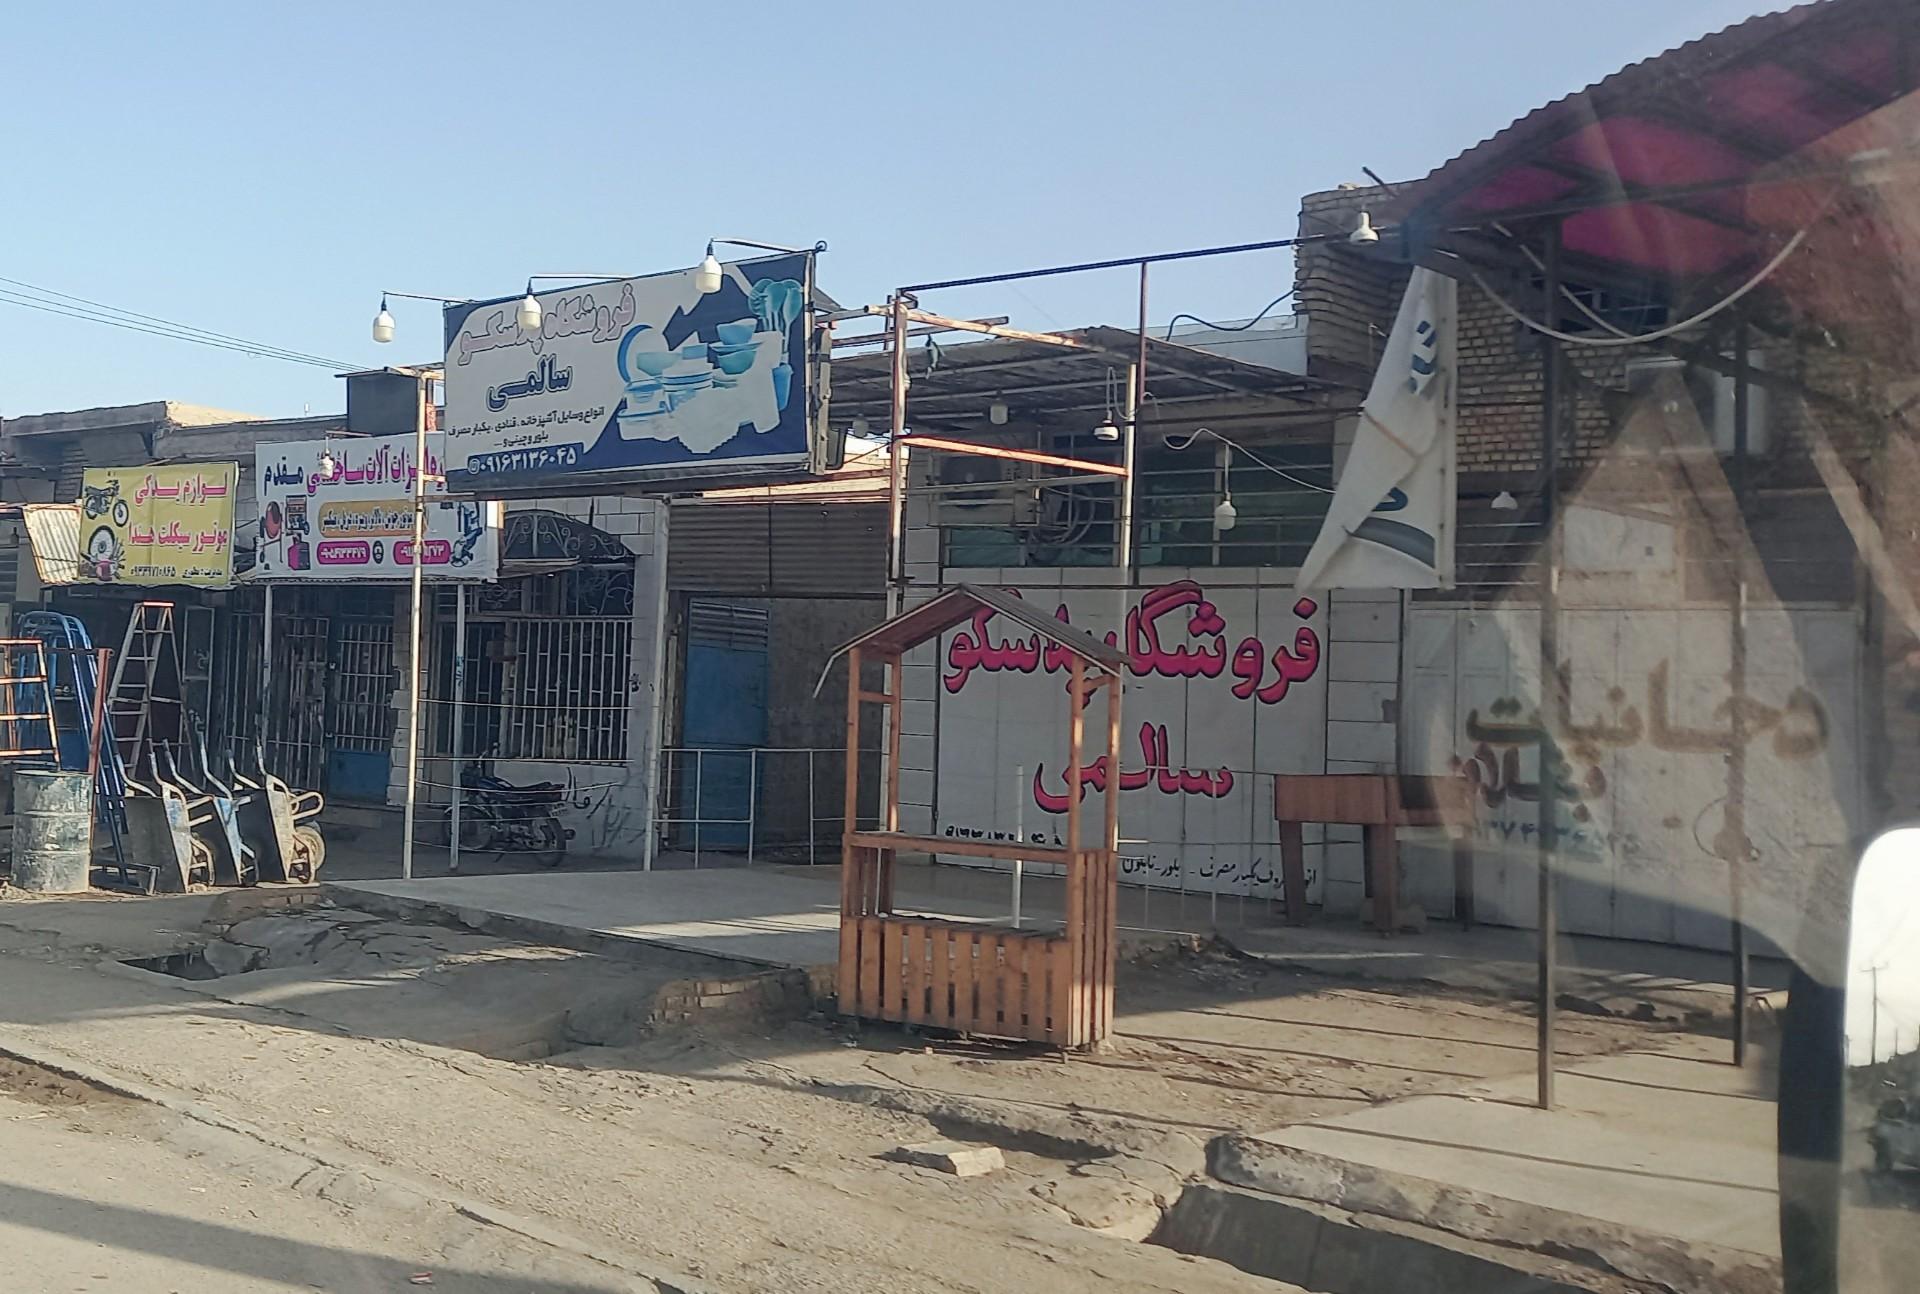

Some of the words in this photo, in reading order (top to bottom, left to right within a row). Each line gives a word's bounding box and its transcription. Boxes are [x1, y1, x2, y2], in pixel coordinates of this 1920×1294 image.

[458, 305, 544, 366] پسکو
[544, 283, 636, 342] فروشگاه
[487, 353, 572, 412] سالمی
[584, 406, 605, 423] انواع
[264, 457, 304, 496] مقدم
[307, 450, 364, 493] ساخنی
[481, 447, 577, 473] ۰۹۱۶۳۱۳۶۰۴۵
[183, 471, 228, 503] لوازم
[192, 522, 228, 552] موتور
[943, 588, 1098, 709] لاسکو
[1104, 580, 1320, 704] فروشگا
[1034, 722, 1233, 813] سالمی
